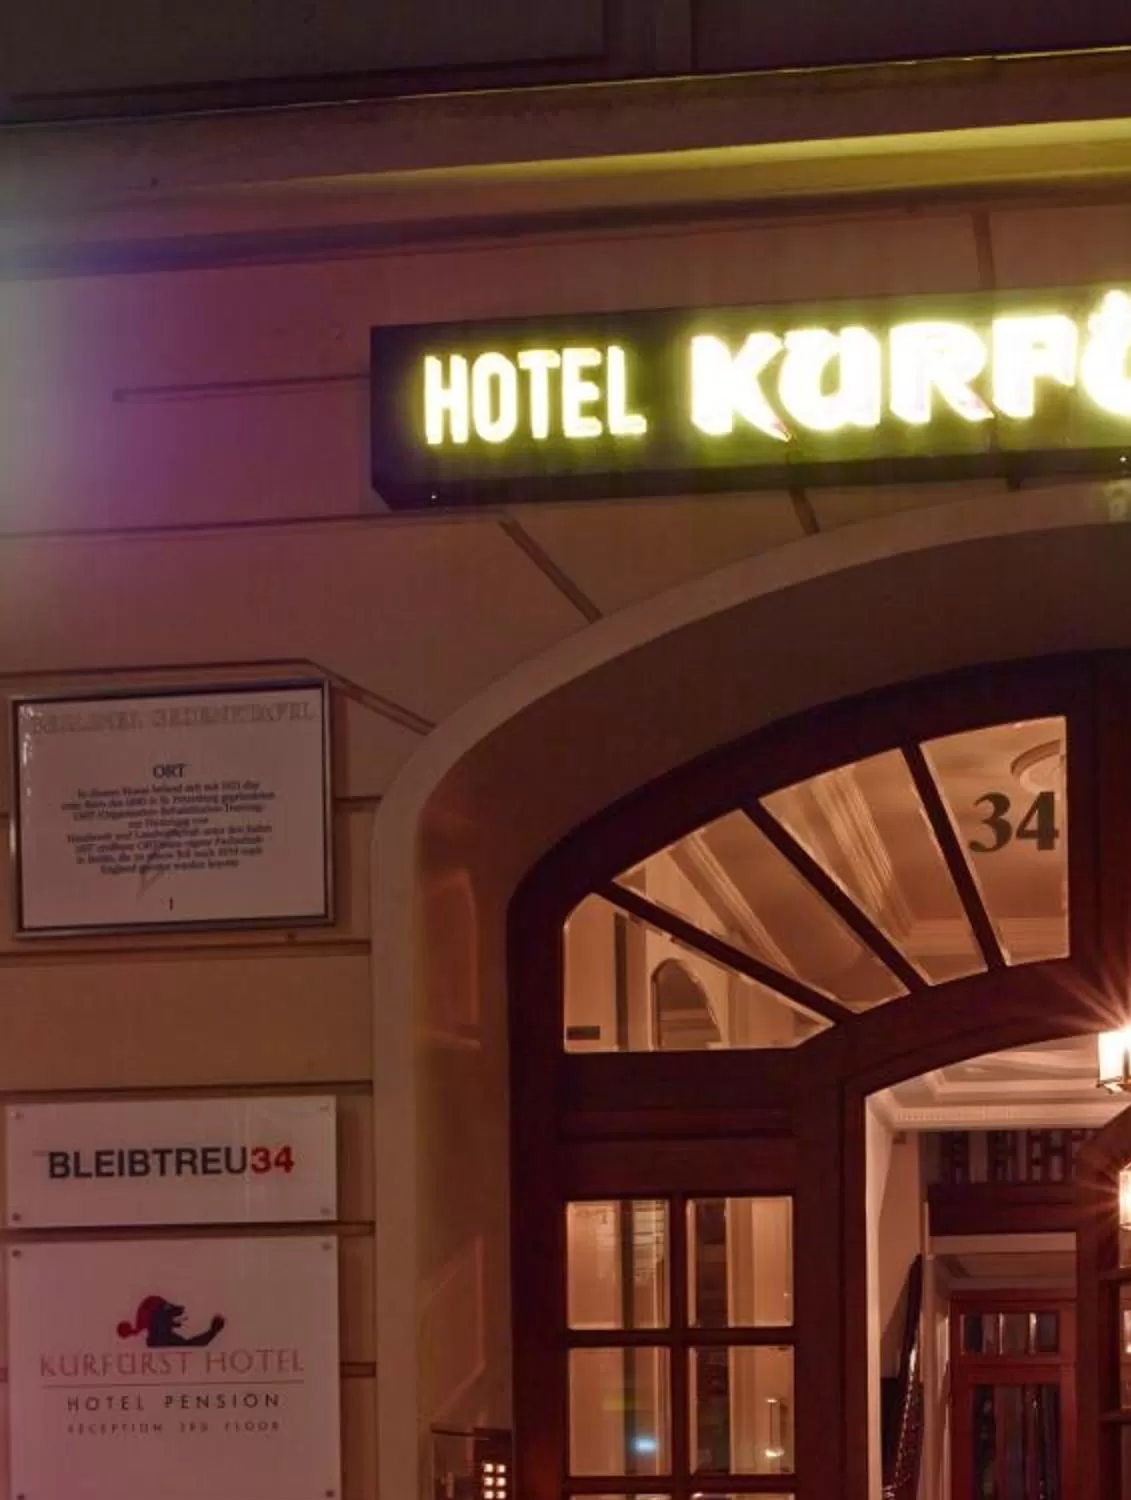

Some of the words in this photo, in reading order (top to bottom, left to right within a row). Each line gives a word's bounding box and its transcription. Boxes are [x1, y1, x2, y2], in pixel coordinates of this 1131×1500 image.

[424, 345, 647, 444] HOTEL
[153, 763, 187, 778] ORT
[969, 791, 1060, 853] 34
[49, 1146, 295, 1180] BLEIBTREU34
[205, 1348, 305, 1374] HOTEL
[67, 1395, 144, 1412] HOTEL
[164, 1393, 280, 1409] PENSION
